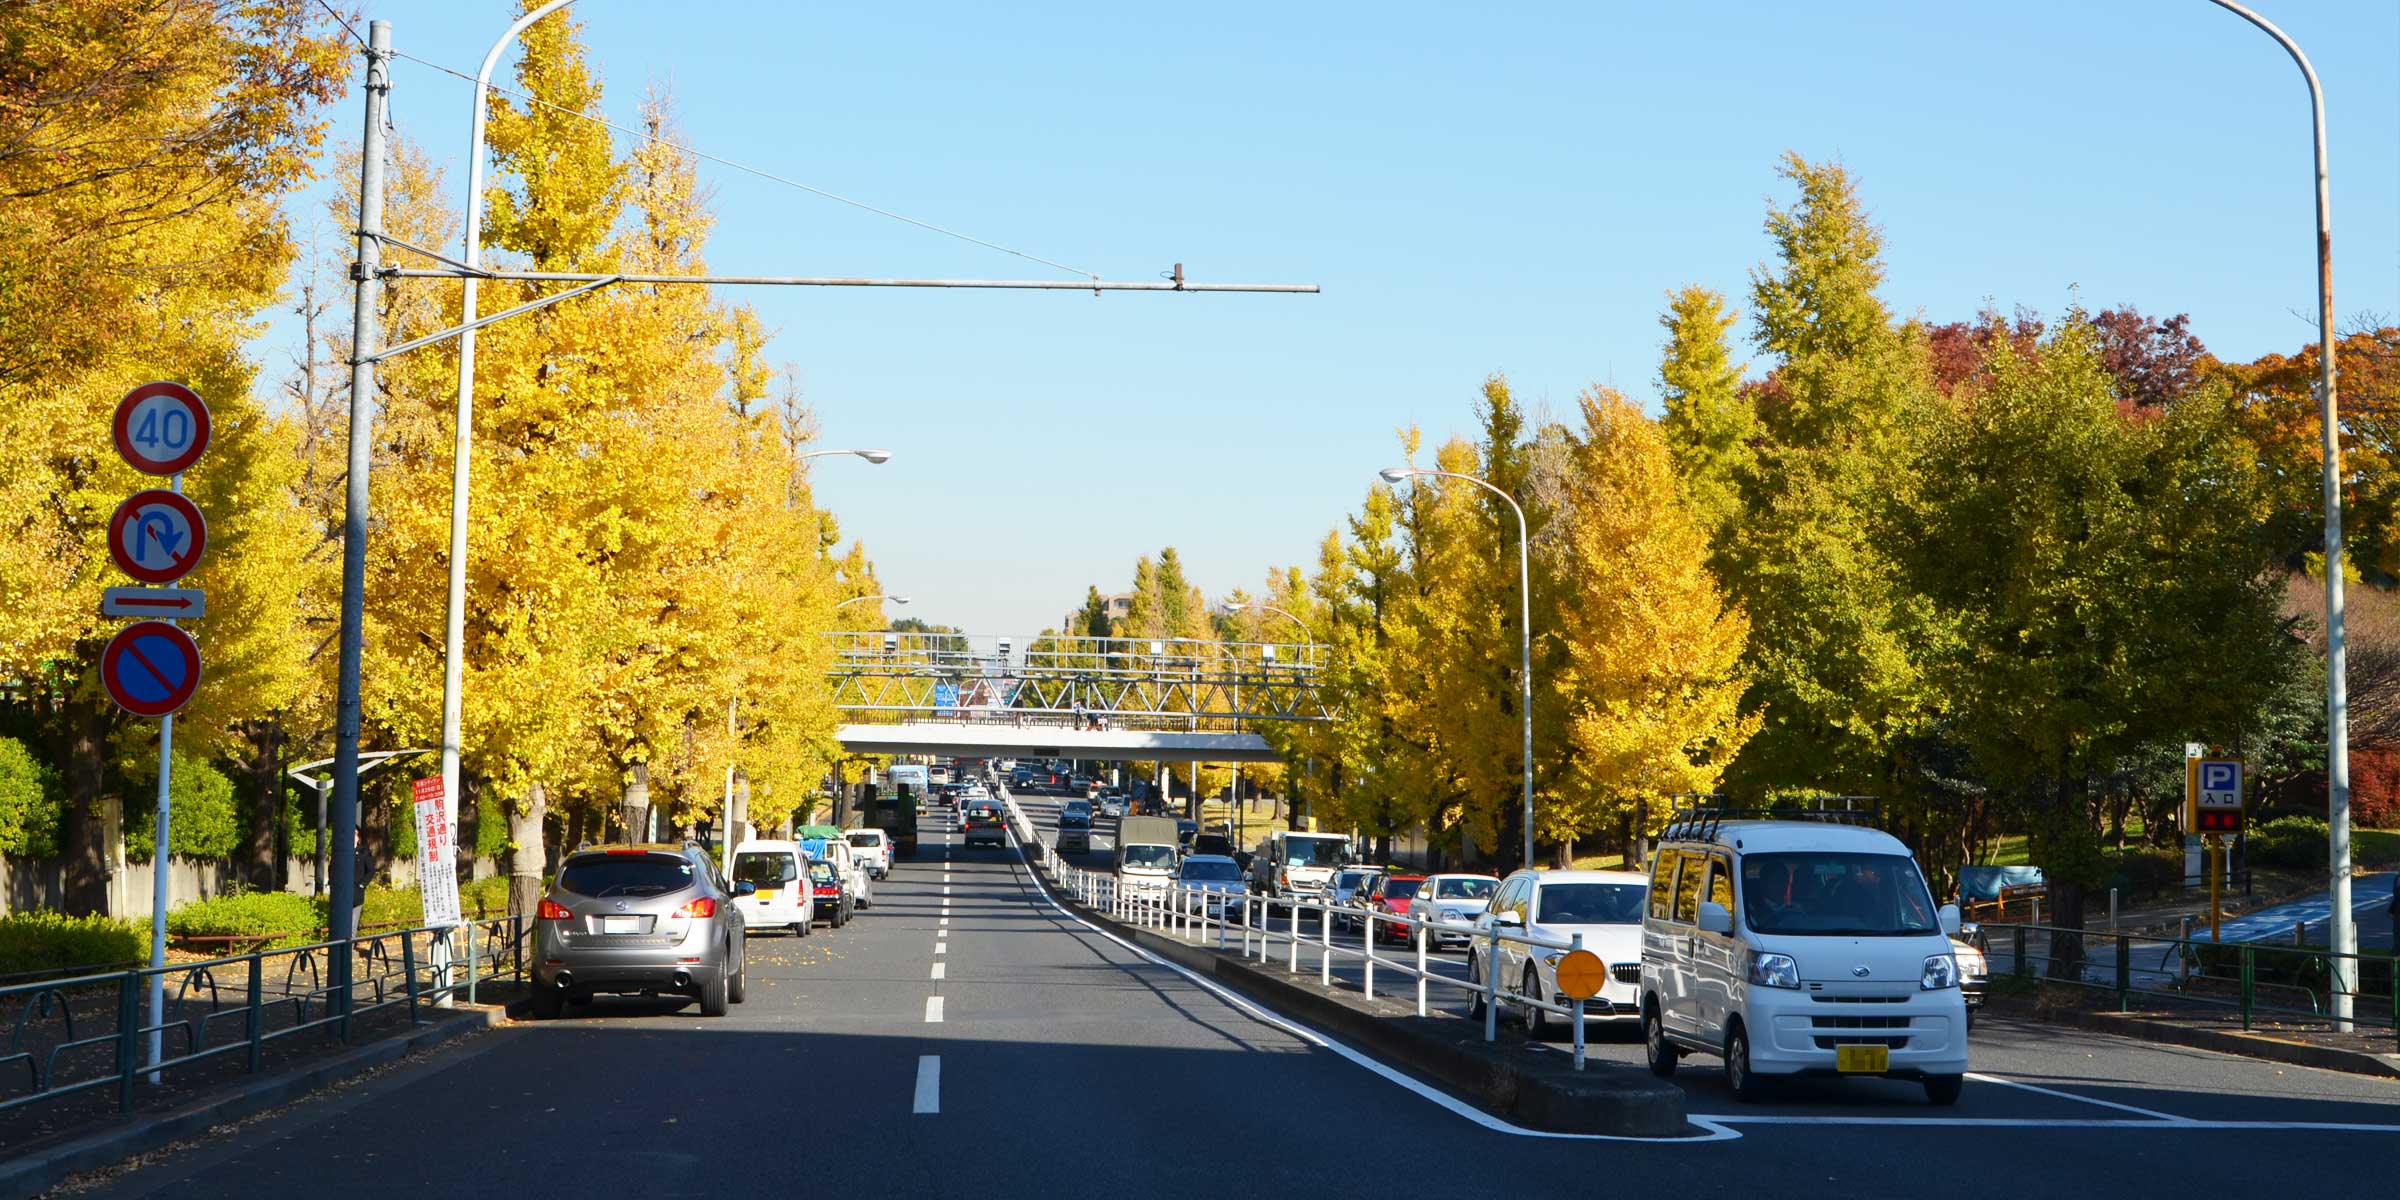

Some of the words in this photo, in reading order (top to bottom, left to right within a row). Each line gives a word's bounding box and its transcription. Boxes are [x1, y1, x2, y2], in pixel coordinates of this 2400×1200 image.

[135, 407, 188, 449] 40
[2207, 766, 2232, 788] P
[2205, 793, 2234, 805] 入口
[425, 813, 439, 863] 交通規制
[434, 798, 447, 847] 駒沢通り
